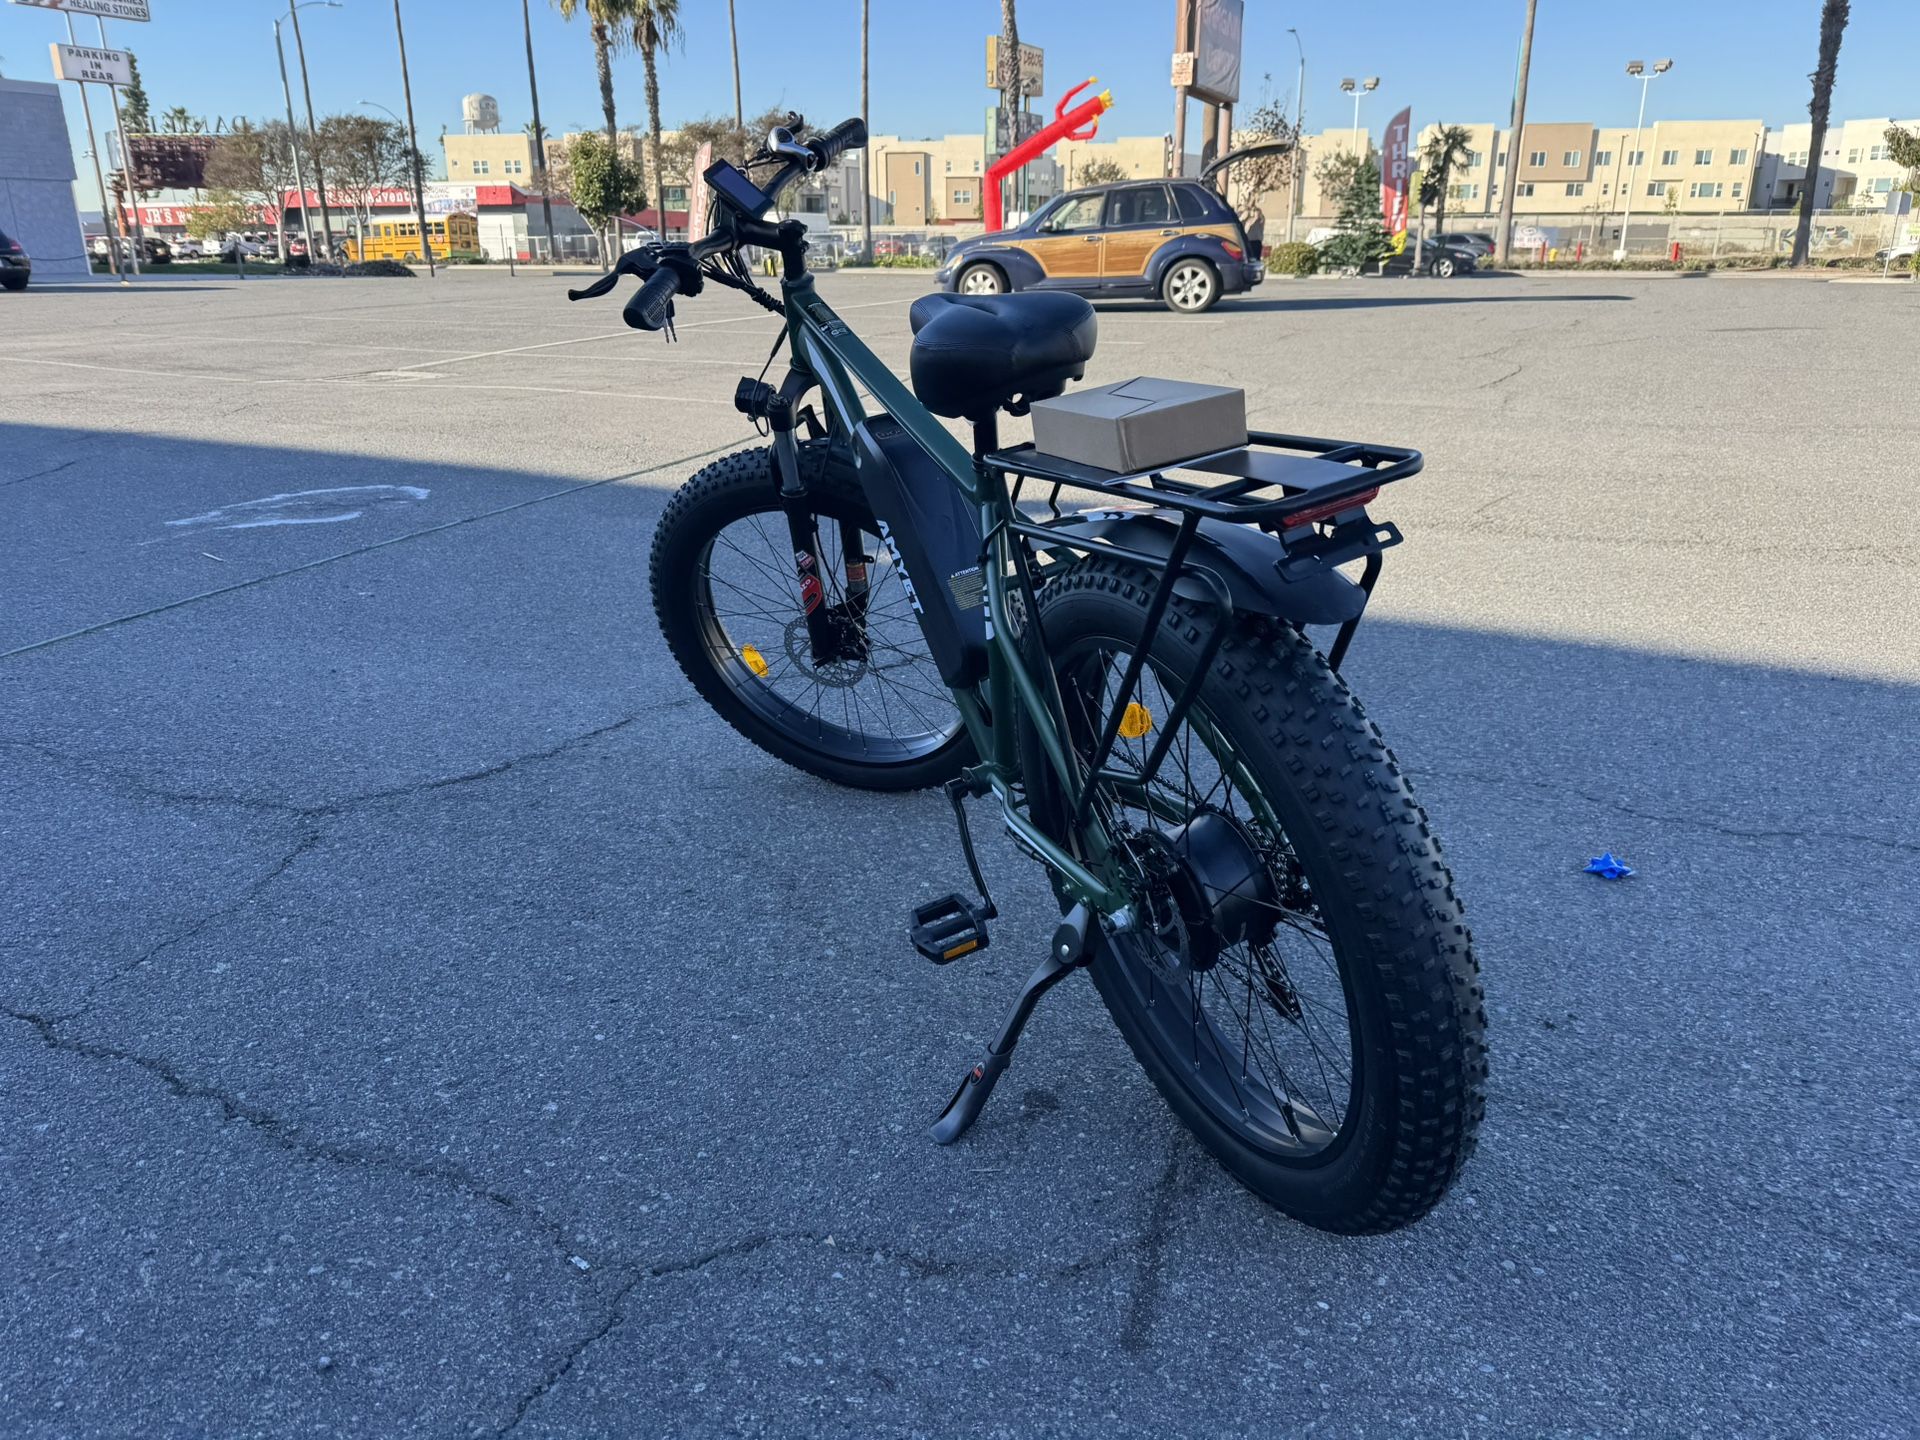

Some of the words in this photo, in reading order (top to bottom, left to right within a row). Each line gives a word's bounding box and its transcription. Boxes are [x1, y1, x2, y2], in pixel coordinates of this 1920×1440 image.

[71, 0, 110, 12] HEALING
[113, 4, 146, 17] STONES
[67, 48, 119, 62] PARKING
[90, 61, 102, 70] IN
[81, 70, 114, 81] REAR
[1392, 124, 1407, 232] THRIFT
[876, 520, 924, 614] AMYET
